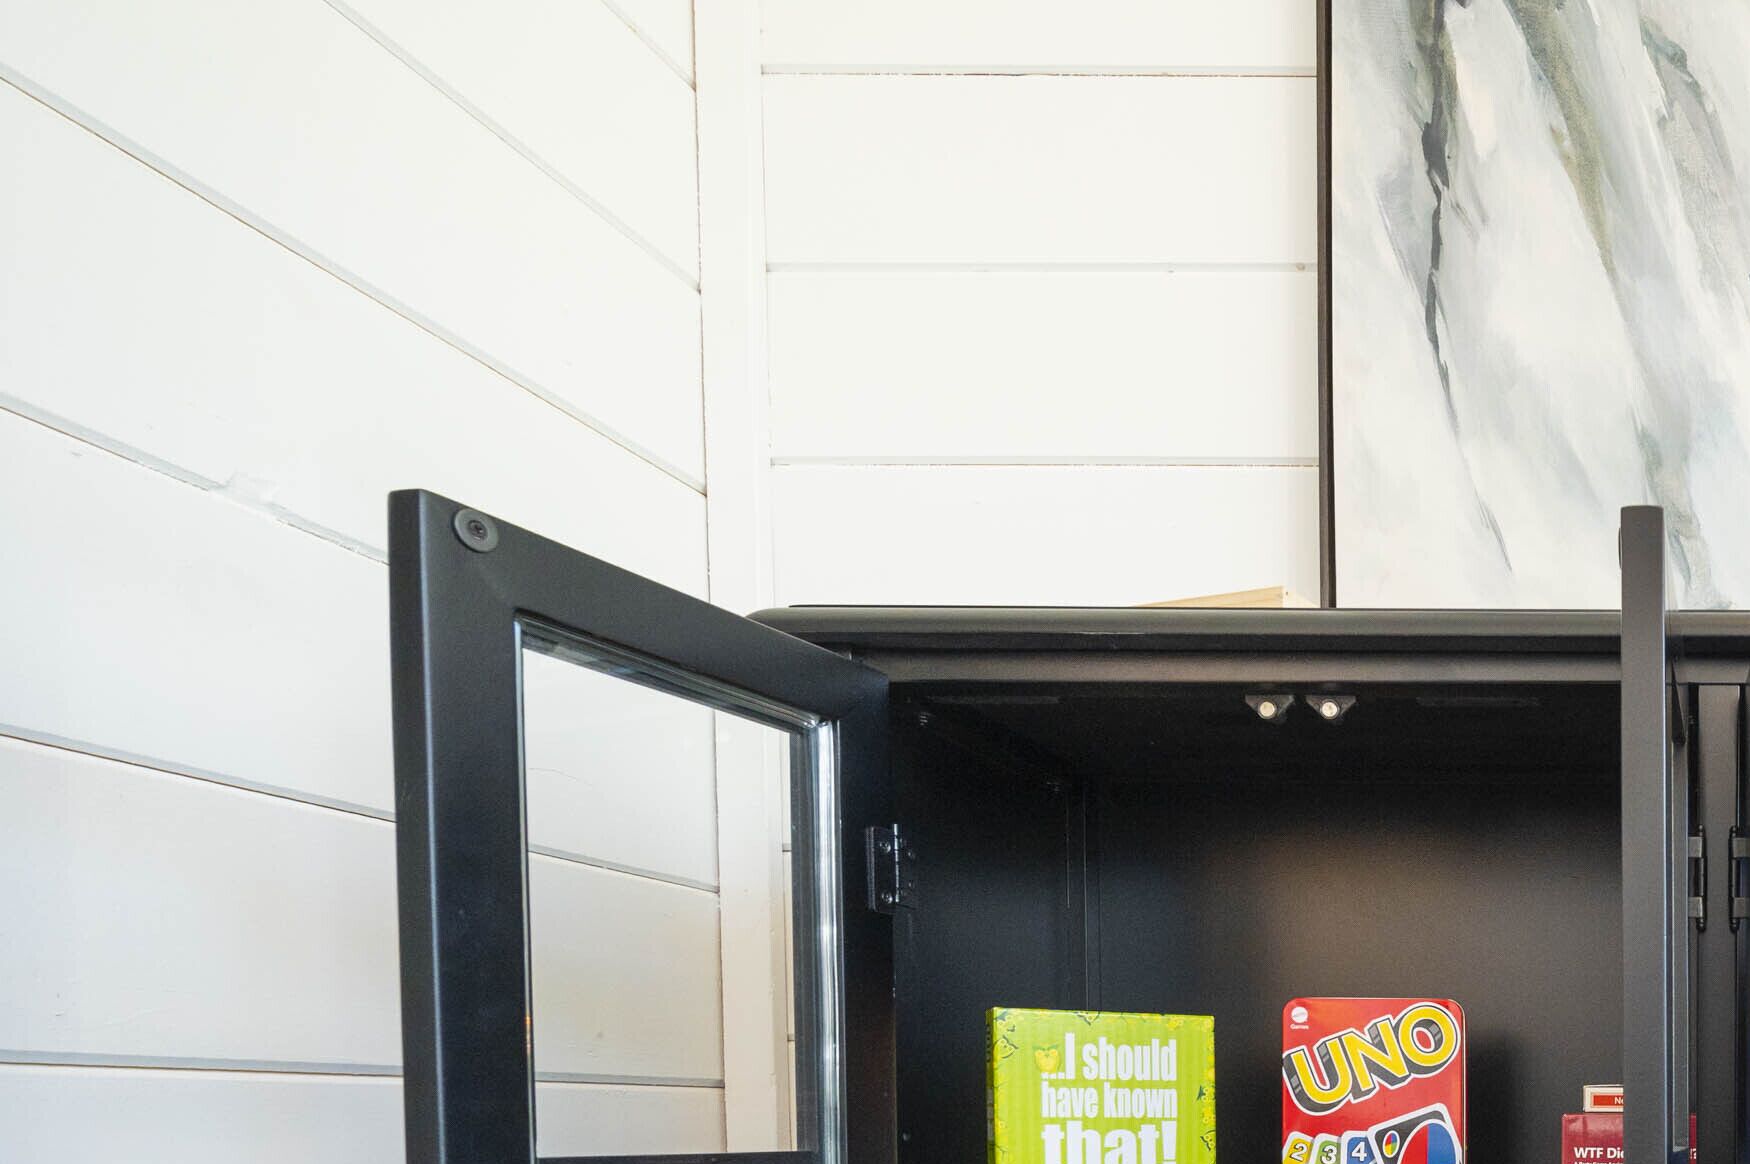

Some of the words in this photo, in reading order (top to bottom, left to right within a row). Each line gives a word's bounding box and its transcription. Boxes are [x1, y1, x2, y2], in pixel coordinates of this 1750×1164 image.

[1083, 1036, 1177, 1081] should
[1285, 1003, 1460, 1113] UNO
[1041, 1081, 1099, 1118] have
[1104, 1081, 1178, 1118] known
[1289, 1143, 1308, 1163] 2
[1321, 1145, 1338, 1164] 3
[1351, 1141, 1367, 1162] 4
[1574, 1147, 1604, 1159] WTF
